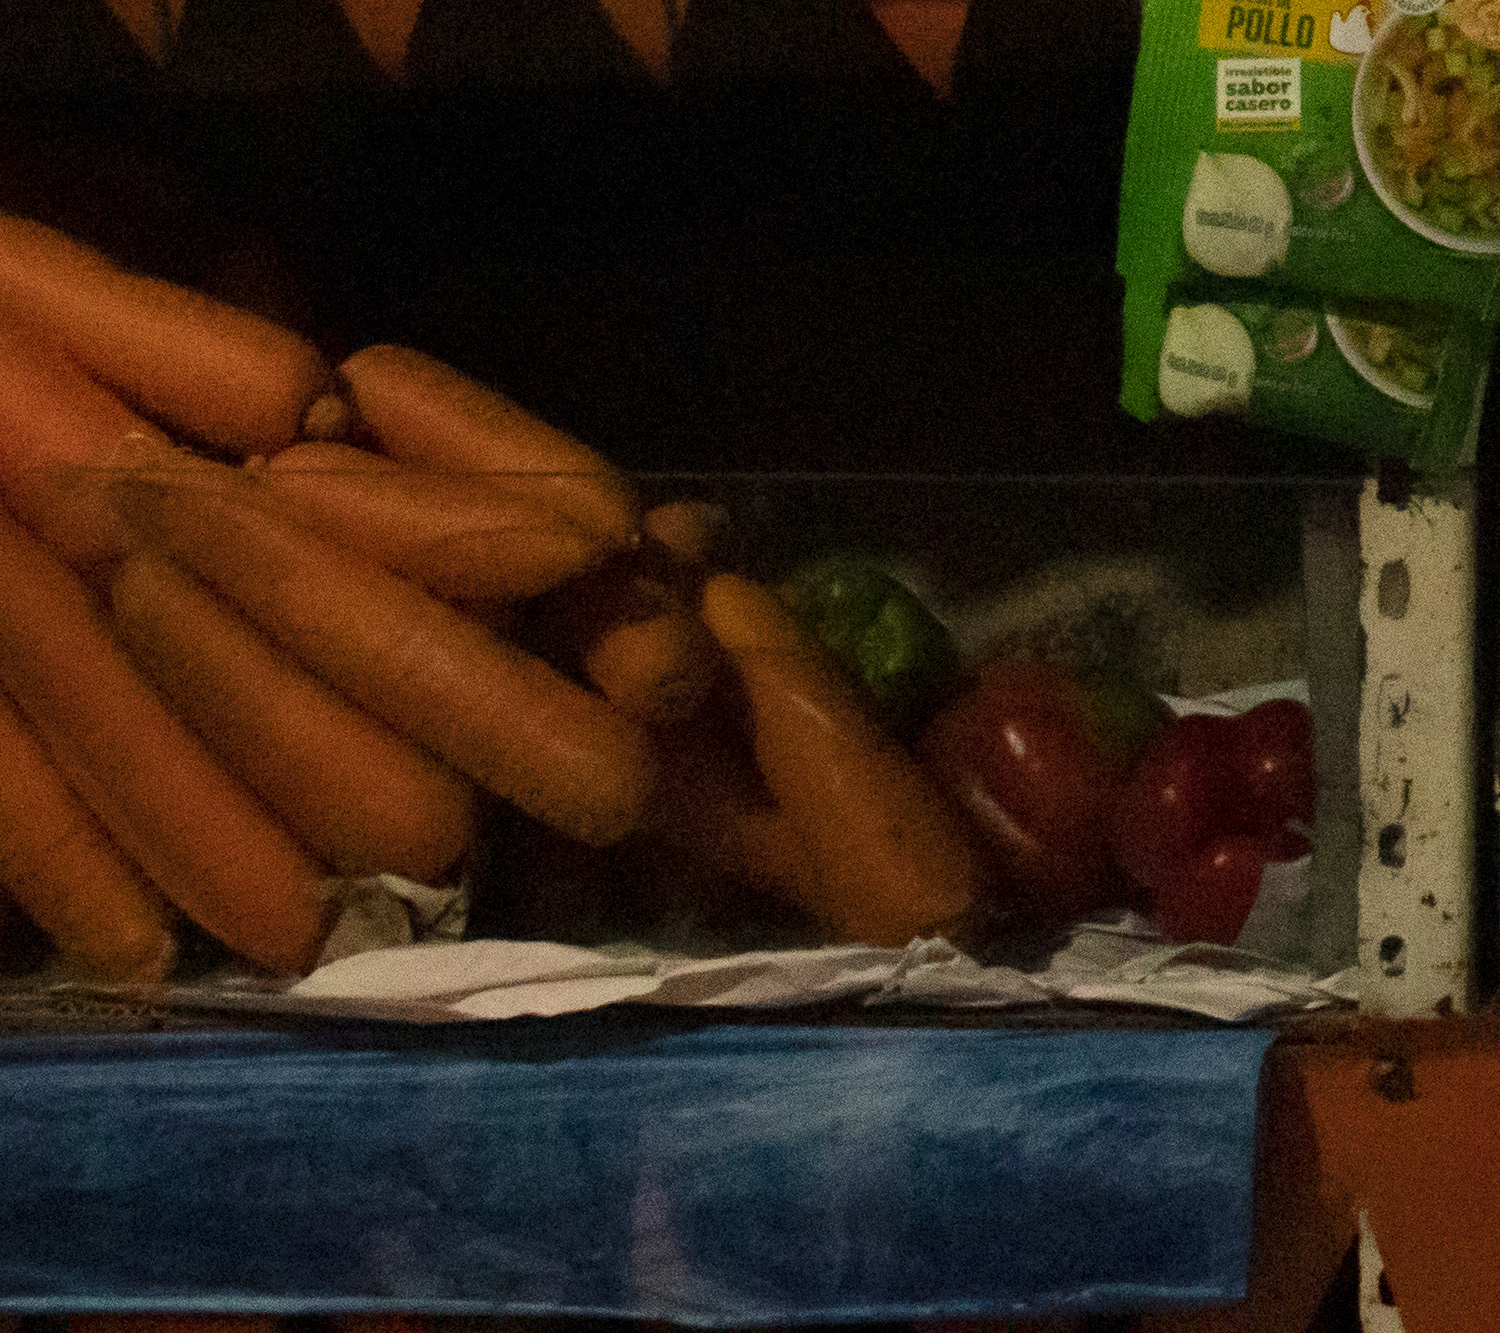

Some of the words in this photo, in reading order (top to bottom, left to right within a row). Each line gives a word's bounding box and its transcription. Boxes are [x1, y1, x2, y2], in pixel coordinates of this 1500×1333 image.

[1226, 4, 1316, 50] POLLO
[1225, 77, 1292, 98] sabor
[1225, 97, 1293, 114] casero
